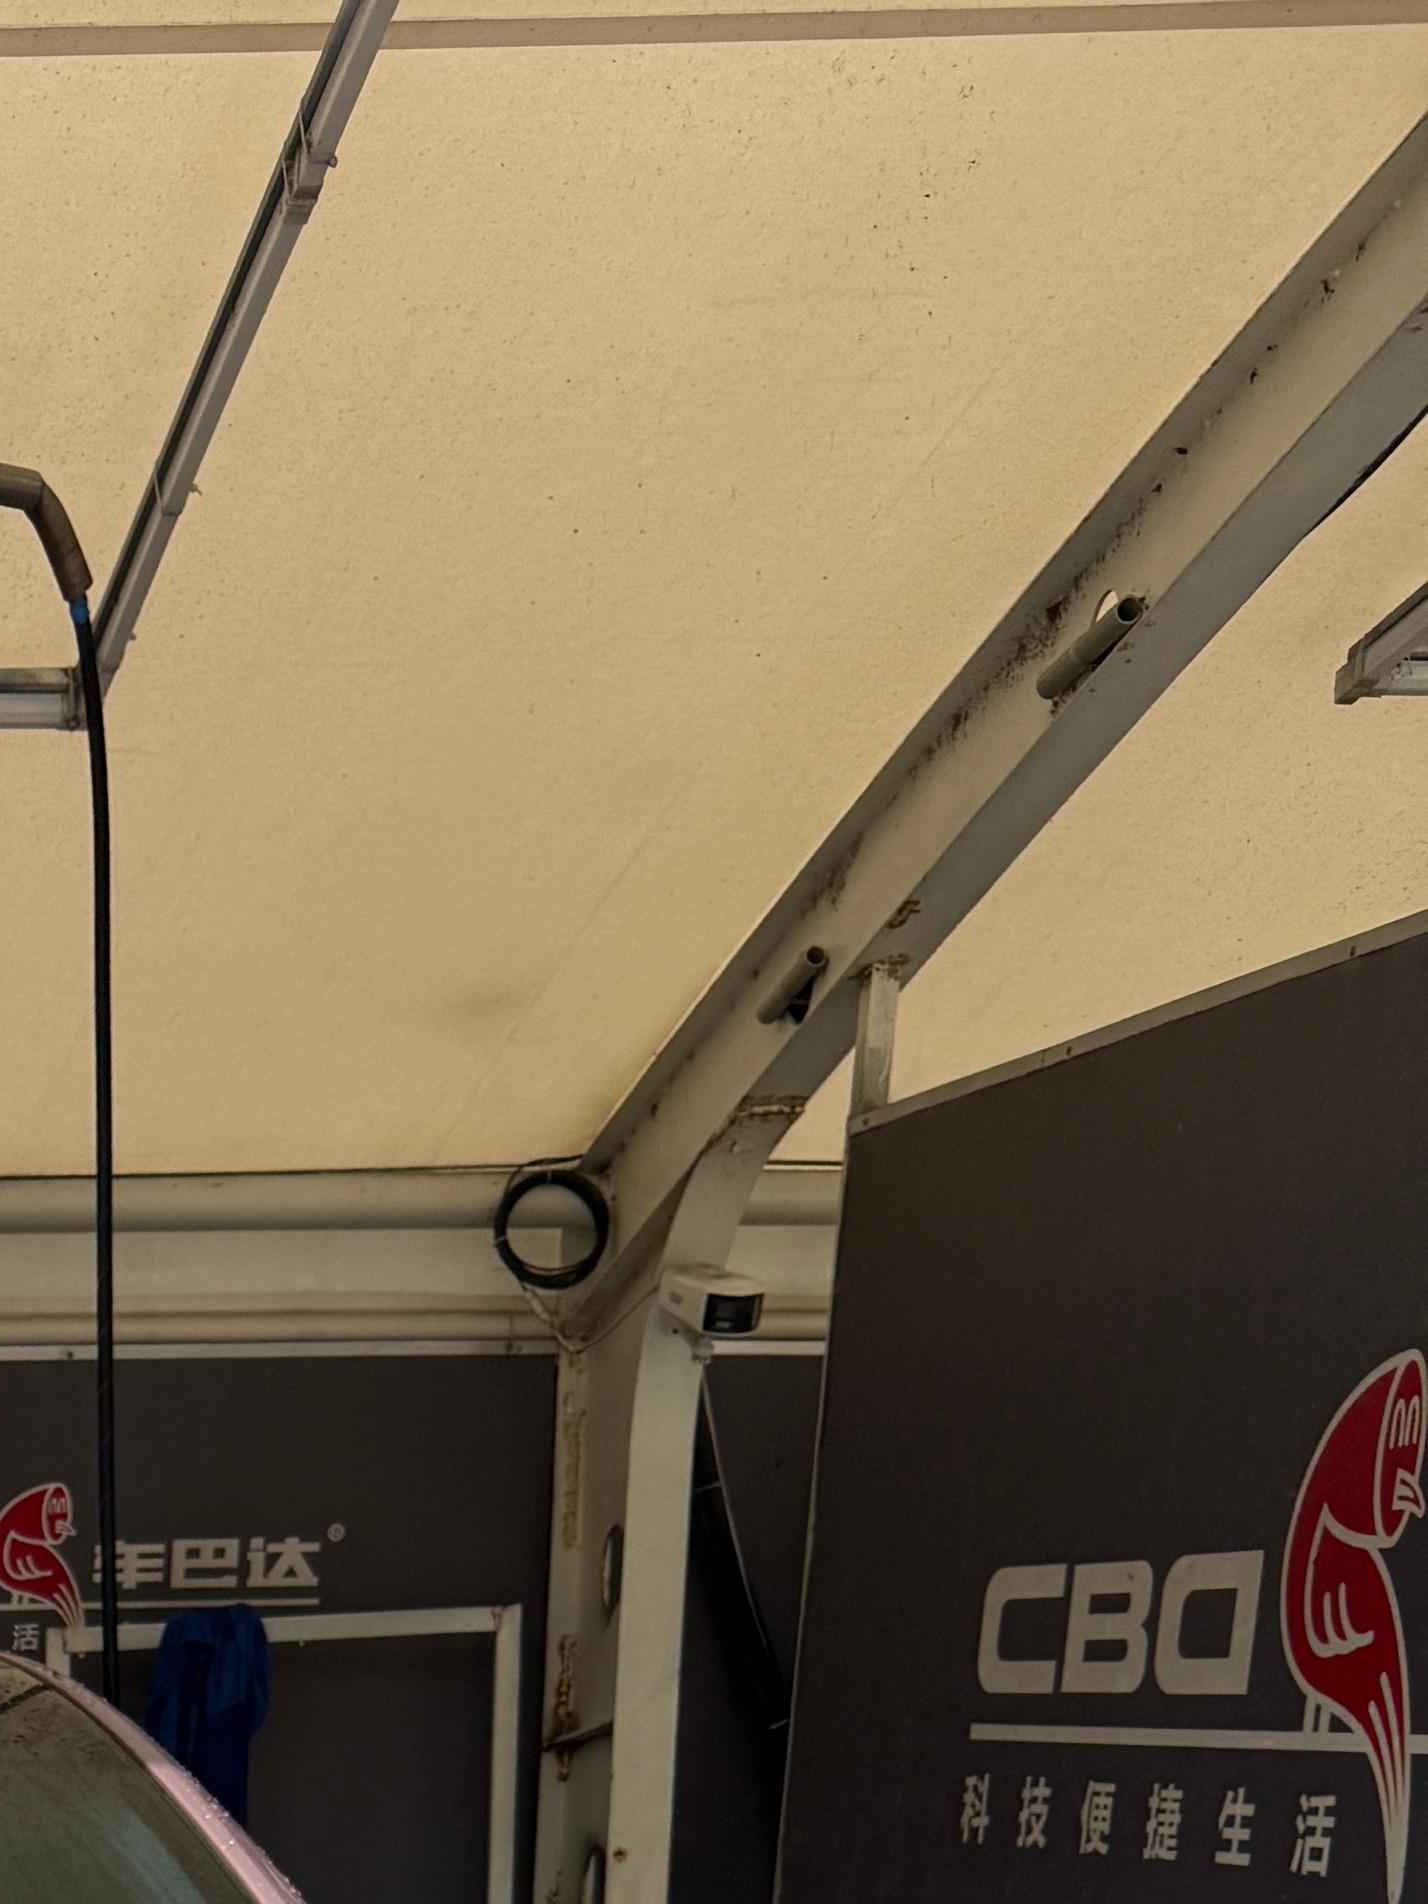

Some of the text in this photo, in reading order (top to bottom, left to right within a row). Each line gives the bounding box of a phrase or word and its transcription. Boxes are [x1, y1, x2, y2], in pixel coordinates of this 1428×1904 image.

[959, 1772, 1337, 1879] 科技便捷生活
